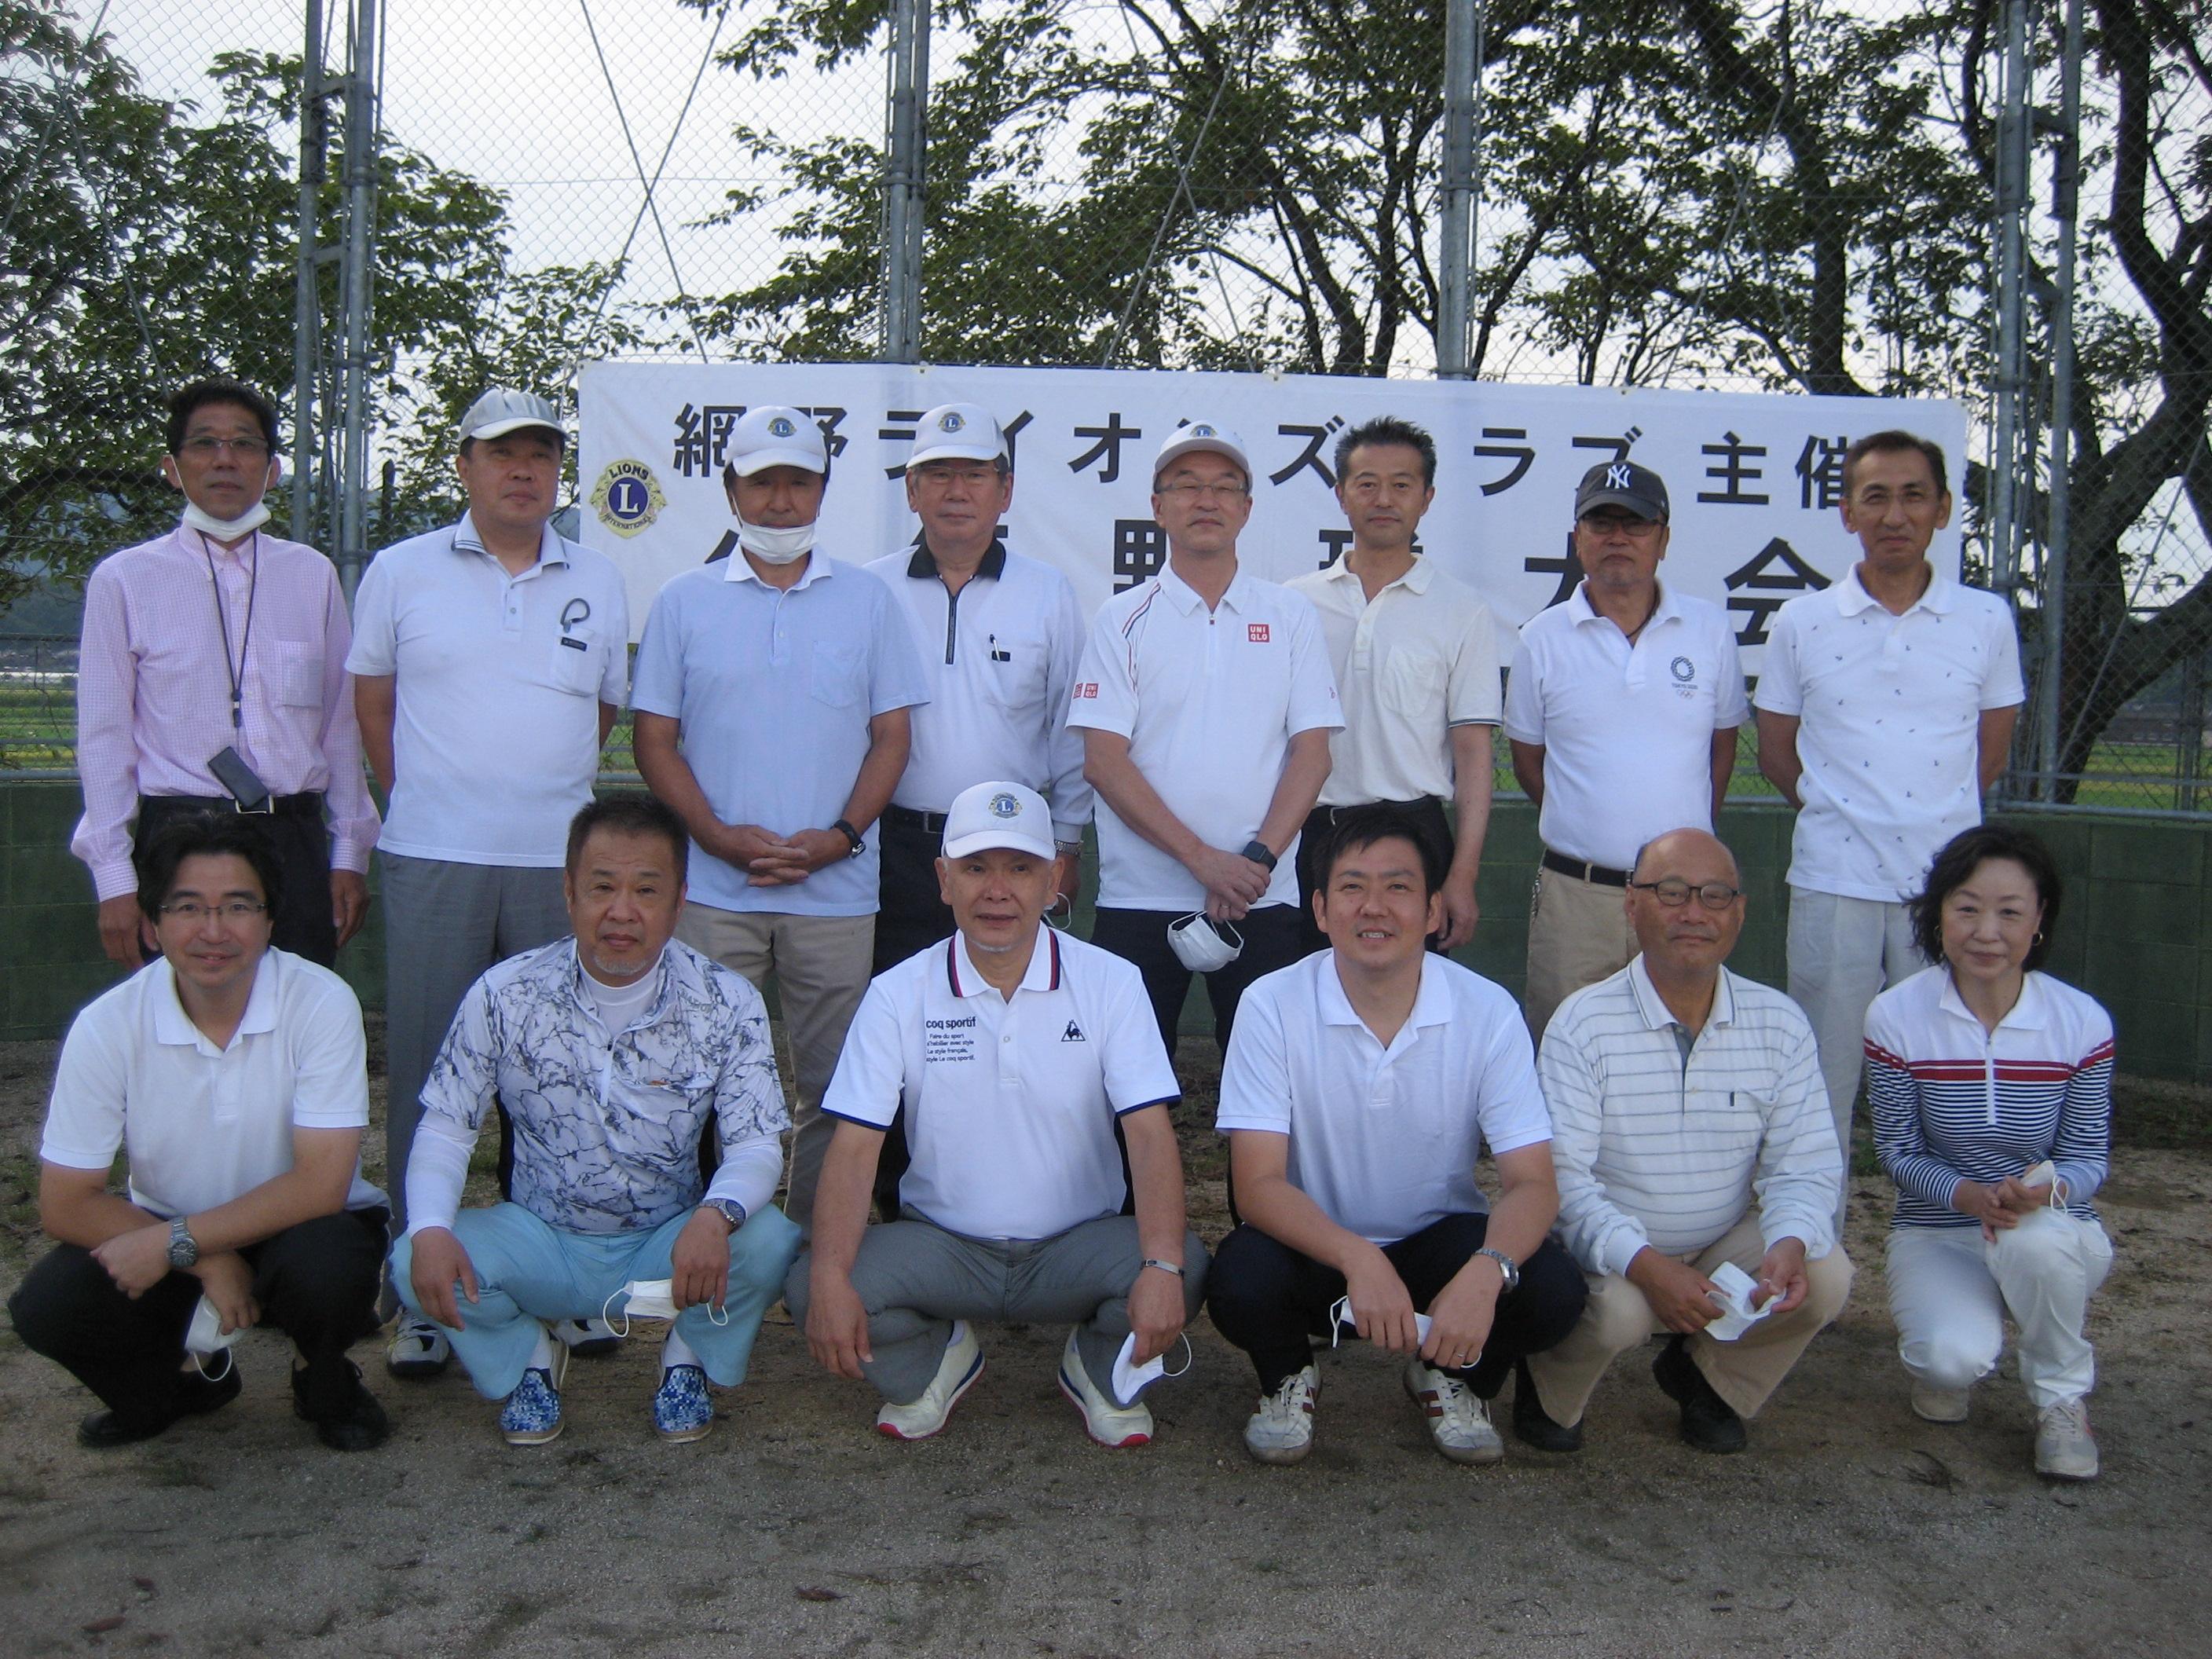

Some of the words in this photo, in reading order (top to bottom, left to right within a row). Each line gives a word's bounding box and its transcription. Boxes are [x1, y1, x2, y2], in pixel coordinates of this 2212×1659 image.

[609, 463, 649, 480] LIONS
[617, 483, 639, 512] L
[1001, 800, 1011, 811] L
[926, 1020, 944, 1030] coq
[945, 1016, 976, 1030] sportif
